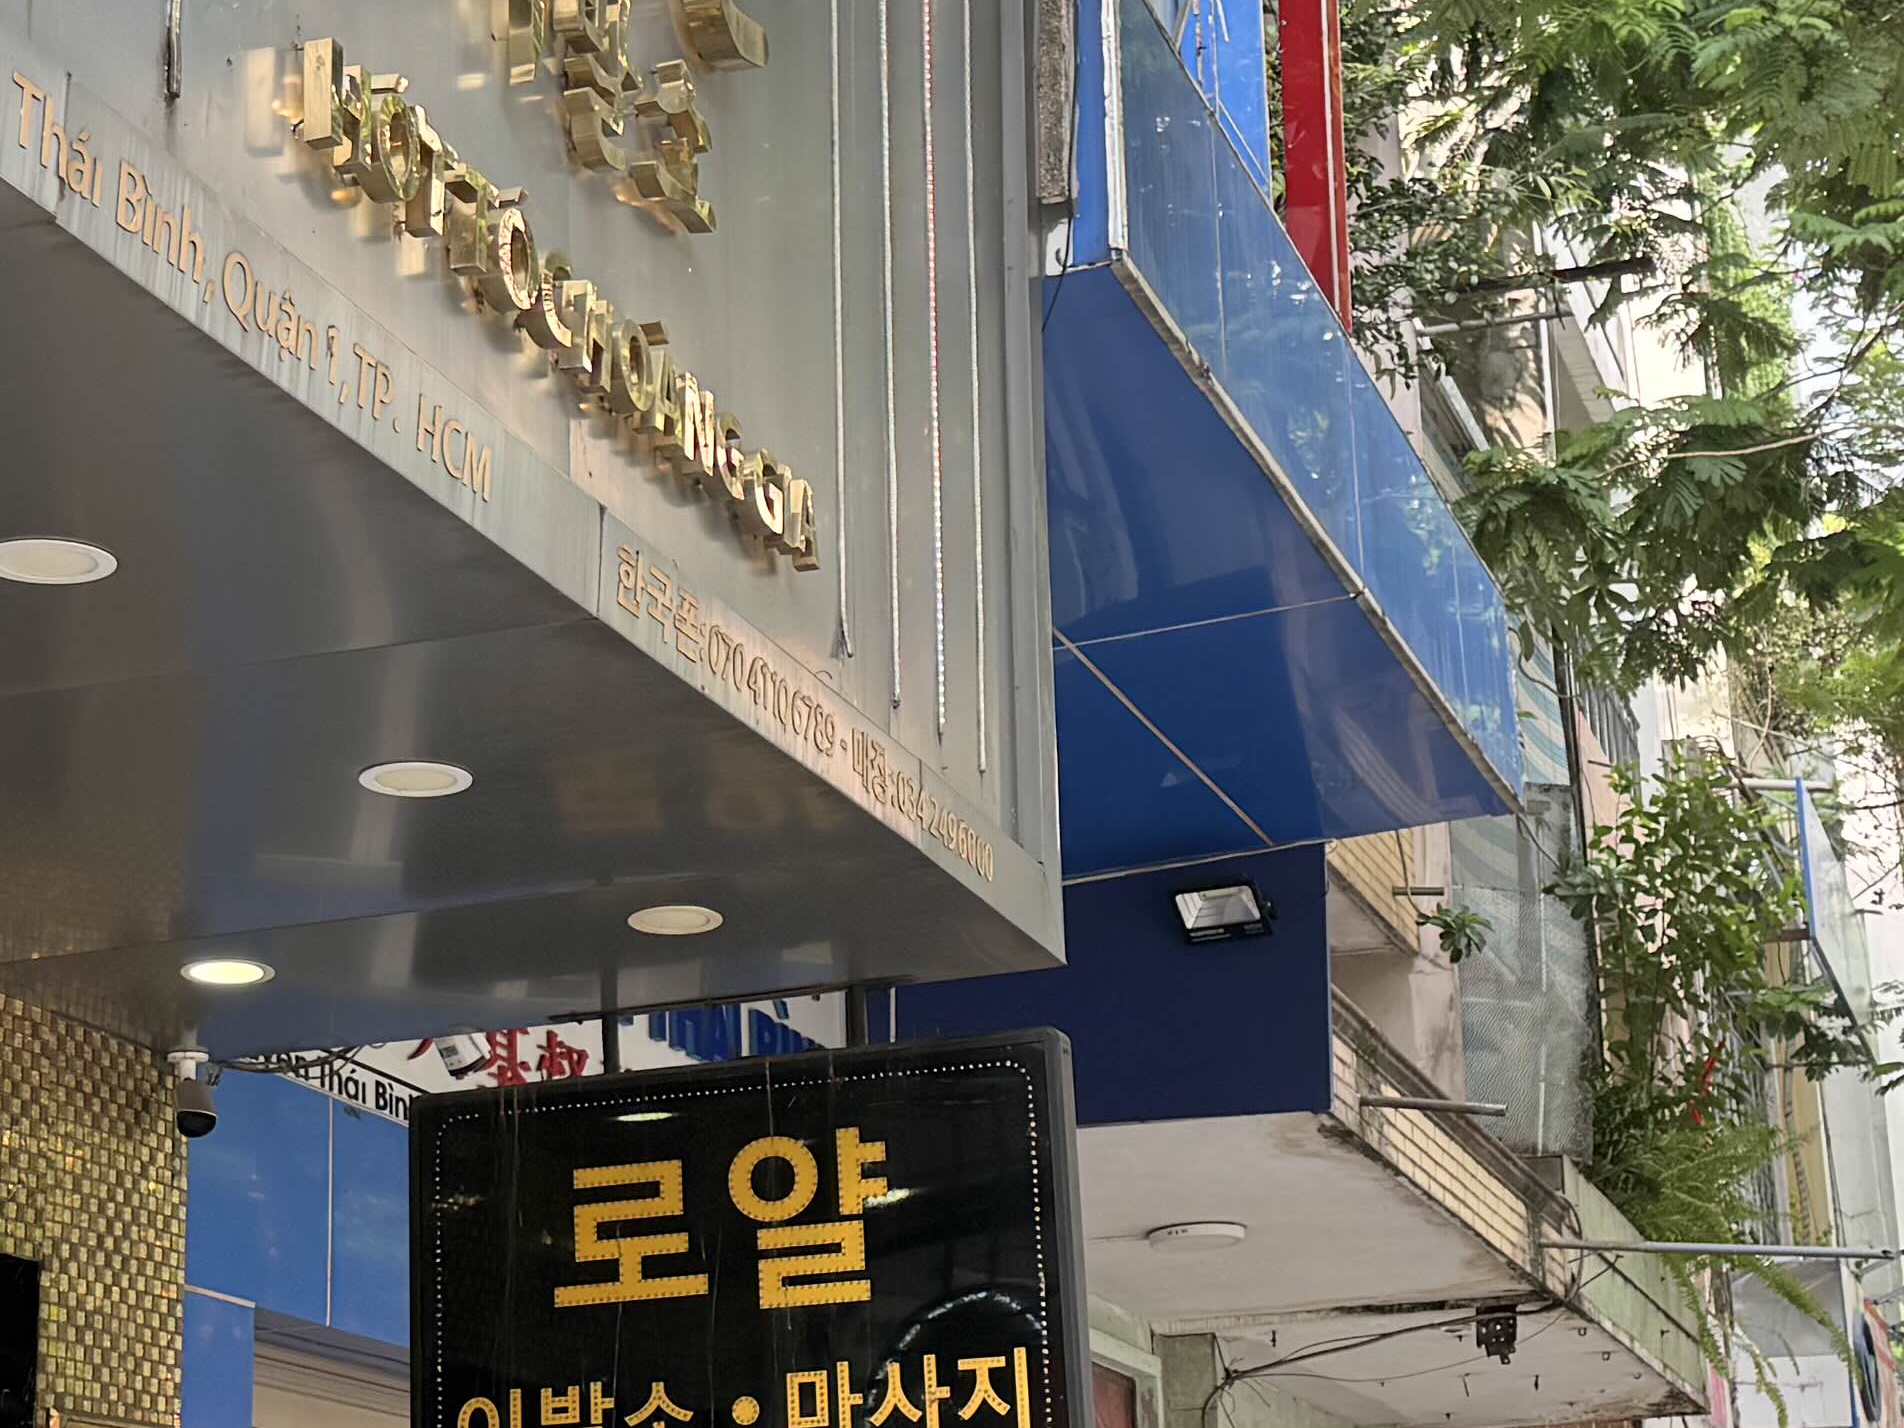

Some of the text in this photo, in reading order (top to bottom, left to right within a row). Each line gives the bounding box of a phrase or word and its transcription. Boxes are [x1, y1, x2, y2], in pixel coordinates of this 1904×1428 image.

[14, 71, 104, 209] Thái
[115, 157, 216, 307] Bình,
[222, 250, 320, 372] Quận
[416, 392, 492, 504] HCM
[375, 1077, 415, 1121] Bìn
[553, 1125, 888, 1310] 로얄
